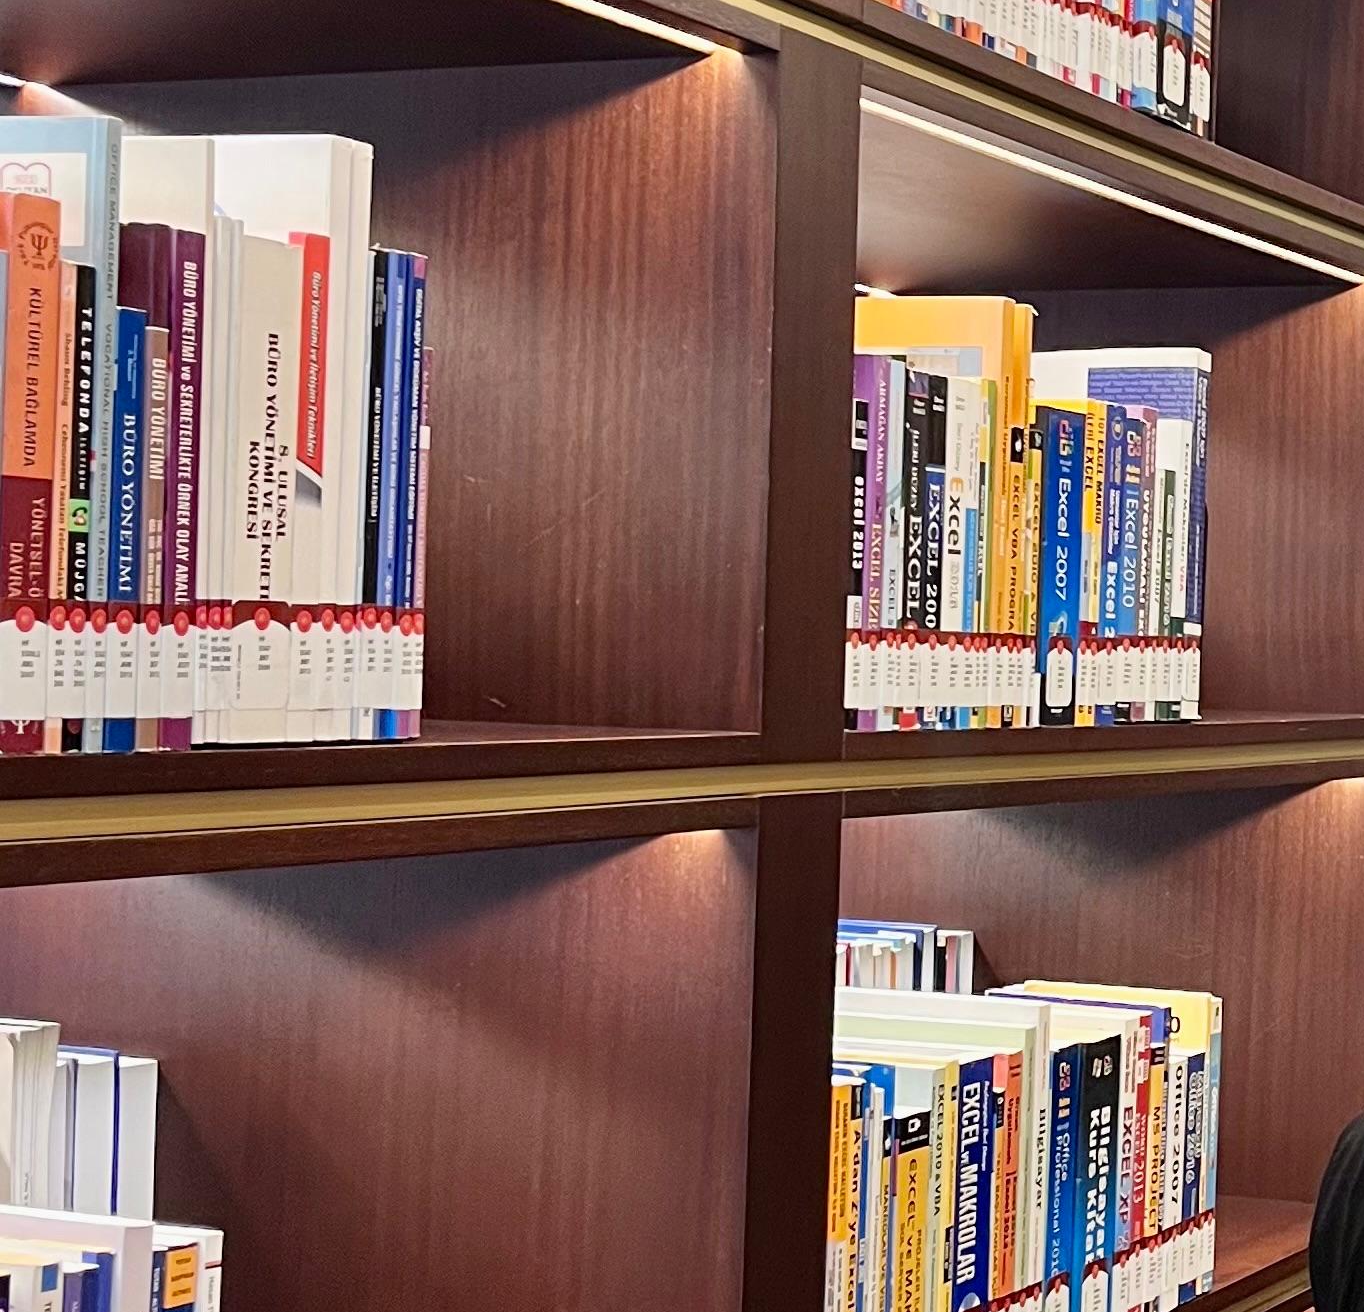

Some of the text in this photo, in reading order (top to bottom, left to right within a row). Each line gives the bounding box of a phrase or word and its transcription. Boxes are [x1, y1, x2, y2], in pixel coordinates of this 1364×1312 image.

[26, 287, 44, 371] KÜLTÜREL
[305, 272, 322, 458] Büro Yönetimi ve İletişim Teknikleri
[79, 307, 93, 433] TELEFONDA
[23, 377, 41, 467] BAĞLAMDA
[121, 414, 137, 475] BÜRO
[149, 358, 166, 480] BÜRO YÖNETİMİ
[175, 261, 198, 561] BÜRO YÖNETİMİ ve SEKRETERLİKTE ÖRNEK OLAY
[261, 333, 281, 513] BÜRO YÖNETİMİ VE
[246, 440, 261, 540] KONGRESİ
[1084, 446, 1094, 491] EXCEL
[1096, 439, 1104, 476] EXCEL
[275, 471, 288, 540] ULUSAL
[926, 483, 941, 576] EXCEL
[948, 477, 964, 555] Excel
[1012, 475, 1021, 520] EXCEL
[117, 482, 136, 592] YÖNETİMİ
[852, 530, 864, 569] 2013
[869, 523, 882, 582] EXCEL
[905, 514, 923, 618] EXCEL
[1011, 528, 1020, 559] VBA
[1055, 477, 1072, 601] Excel 2007
[1122, 498, 1139, 607] Excel 2010
[888, 569, 897, 612] EXCEL
[1104, 560, 1118, 619] Excel
[936, 1084, 945, 1129] EXCEL
[961, 1081, 980, 1151] EXCEL
[1087, 1108, 1100, 1178] Kurs
[1171, 1065, 1183, 1204] Office 2007
[850, 1130, 862, 1193] A'dan
[935, 1133, 944, 1169] 2010
[1035, 1109, 1047, 1210] Bilgisayar
[1060, 1132, 1071, 1181] Office
[1096, 1105, 1112, 1258] Bilgisayar
[1120, 1106, 1134, 1188] EXCEL
[1132, 1161, 1145, 1204] 2013
[1148, 1106, 1161, 1229] MS PROJECT
[907, 1159, 917, 1222] EXCEL
[934, 1184, 942, 1216] VBA
[1052, 1135, 1064, 1234] Professional
[1119, 1194, 1131, 1225] XP
[956, 1164, 978, 1285] MAKROLAR
[846, 1253, 857, 1309] Excel
